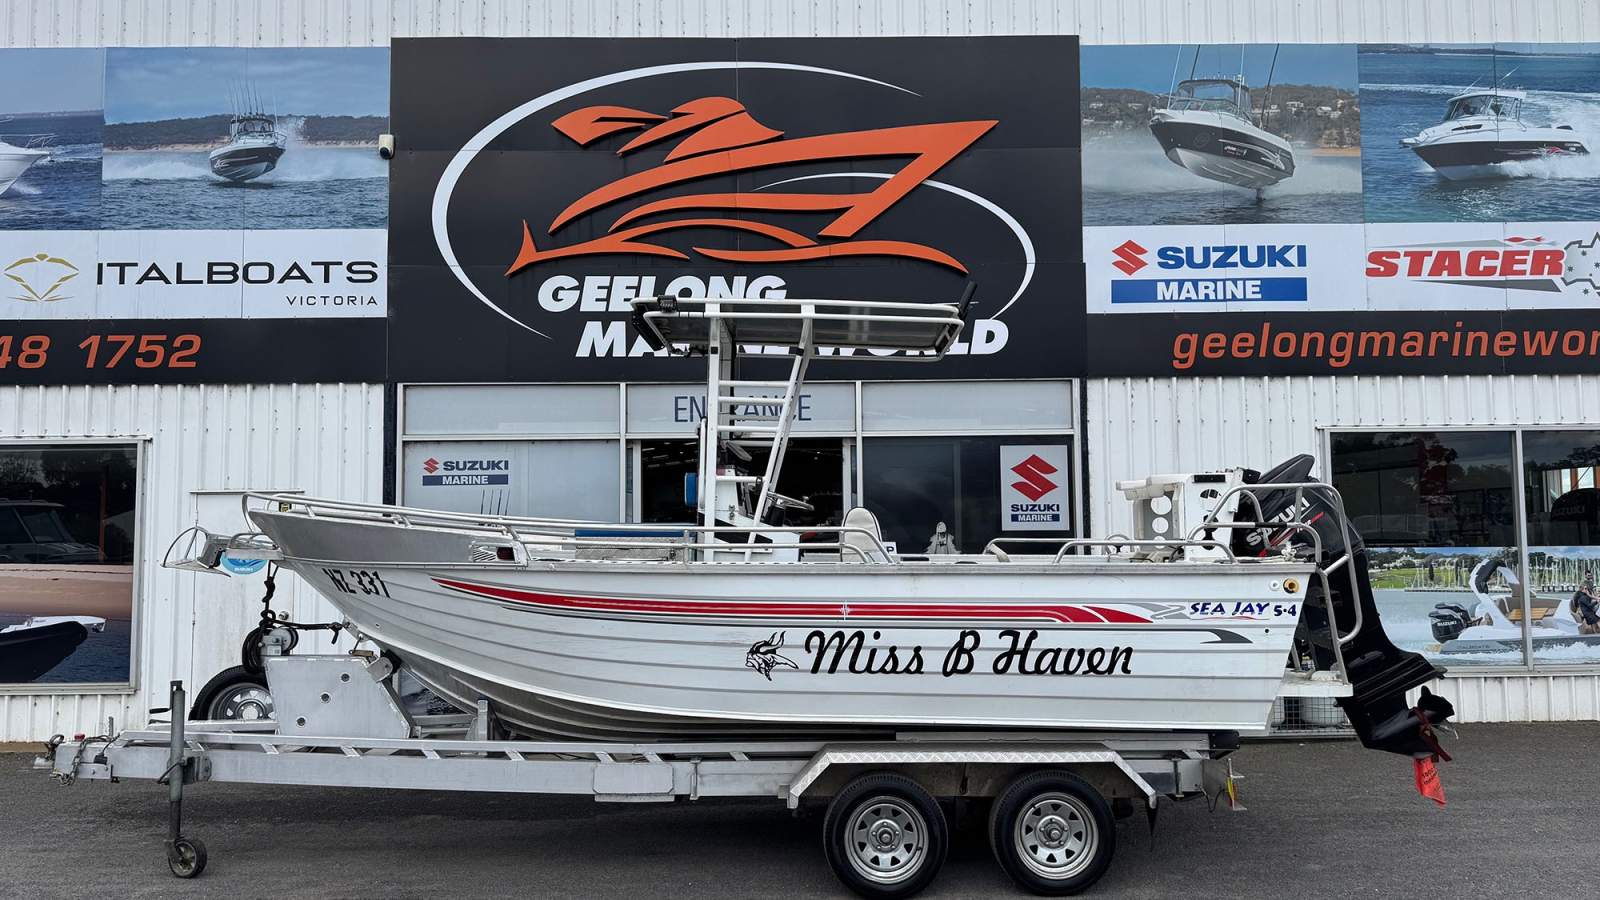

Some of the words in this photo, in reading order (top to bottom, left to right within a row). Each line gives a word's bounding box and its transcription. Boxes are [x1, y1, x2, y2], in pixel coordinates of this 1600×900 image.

[1157, 244, 1306, 270] SUZUKI
[1366, 249, 1567, 278] STACER
[97, 261, 378, 285] ITALBOATS
[286, 295, 378, 306] VICTORIA
[1156, 279, 1262, 302] MARINE
[79, 335, 202, 369] 1752
[443, 460, 508, 471] SUZUKI
[442, 474, 489, 485] MARINE
[1011, 504, 1060, 512] SUZUKI
[1018, 514, 1053, 522] MARINE
[350, 570, 390, 598] 331
[1190, 602, 1225, 615] SEA
[1232, 601, 1270, 615] JAY
[804, 629, 924, 675] Miss
[942, 629, 980, 676] B
[992, 629, 1133, 676] Haven
